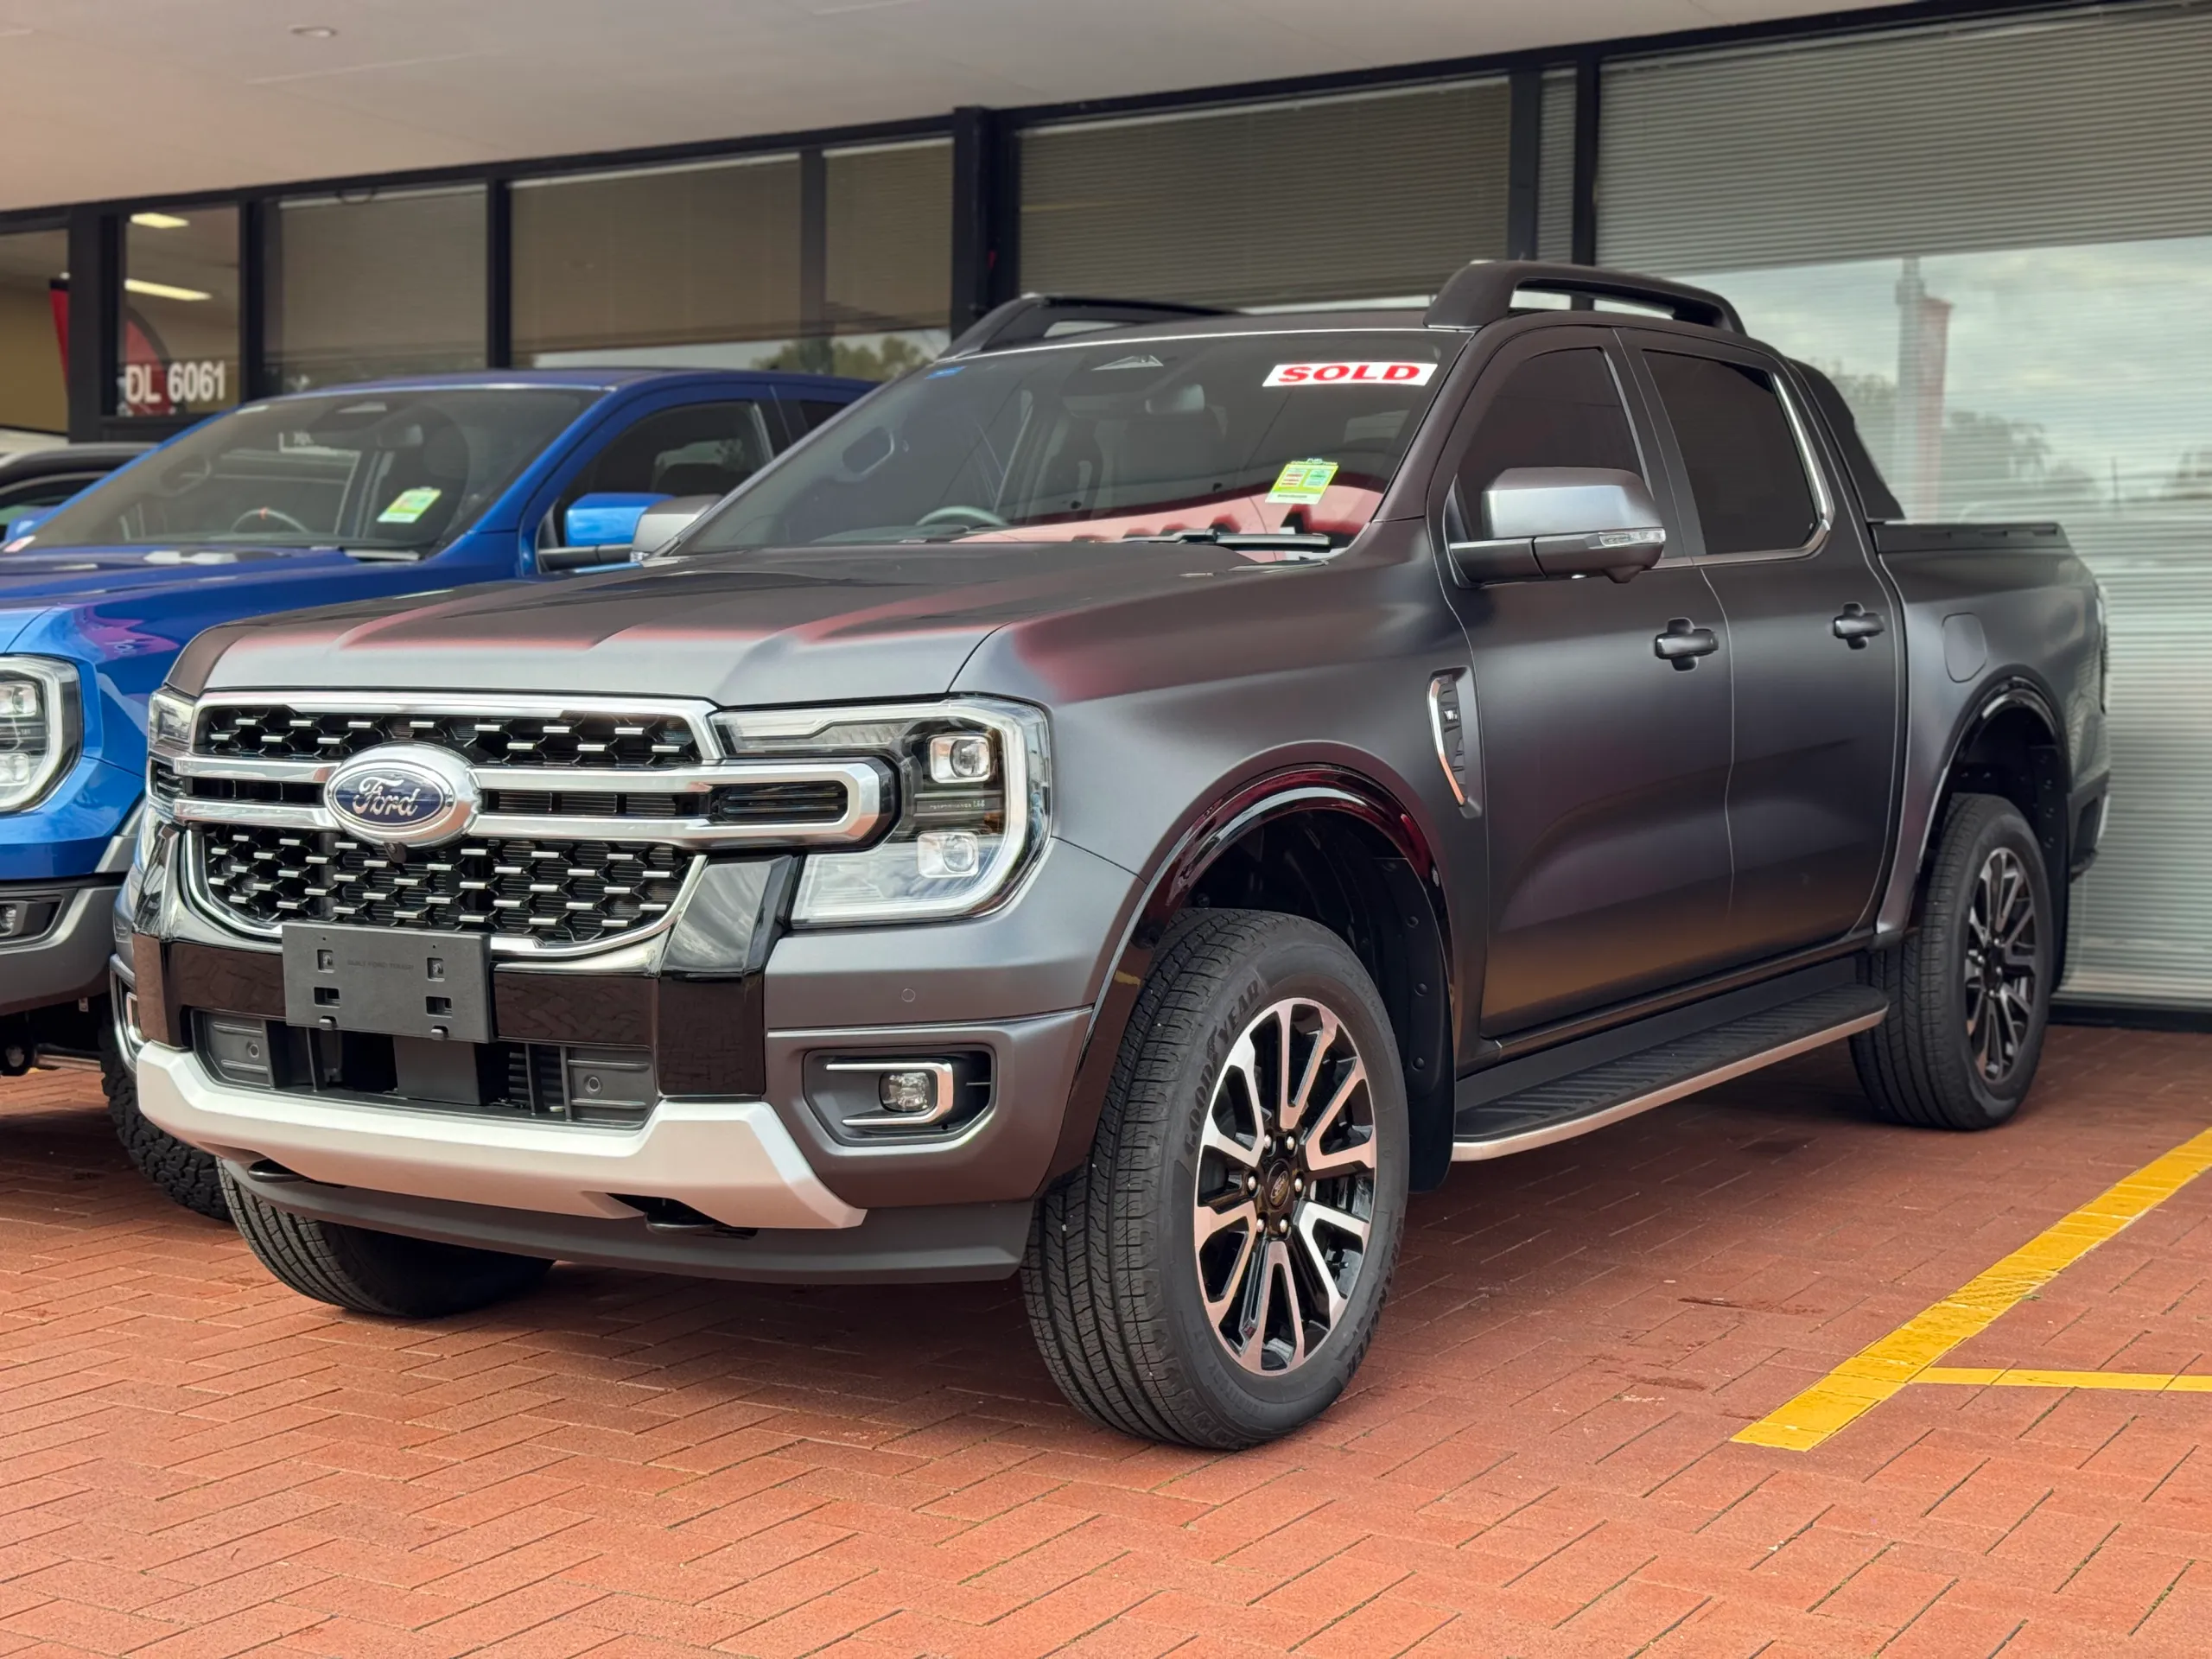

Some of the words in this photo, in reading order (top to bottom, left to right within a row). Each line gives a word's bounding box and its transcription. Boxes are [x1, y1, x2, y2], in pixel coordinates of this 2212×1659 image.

[125, 364, 162, 404] DL
[168, 360, 226, 403] 6061
[1278, 365, 1421, 382] SOLD
[352, 776, 421, 817] Ford
